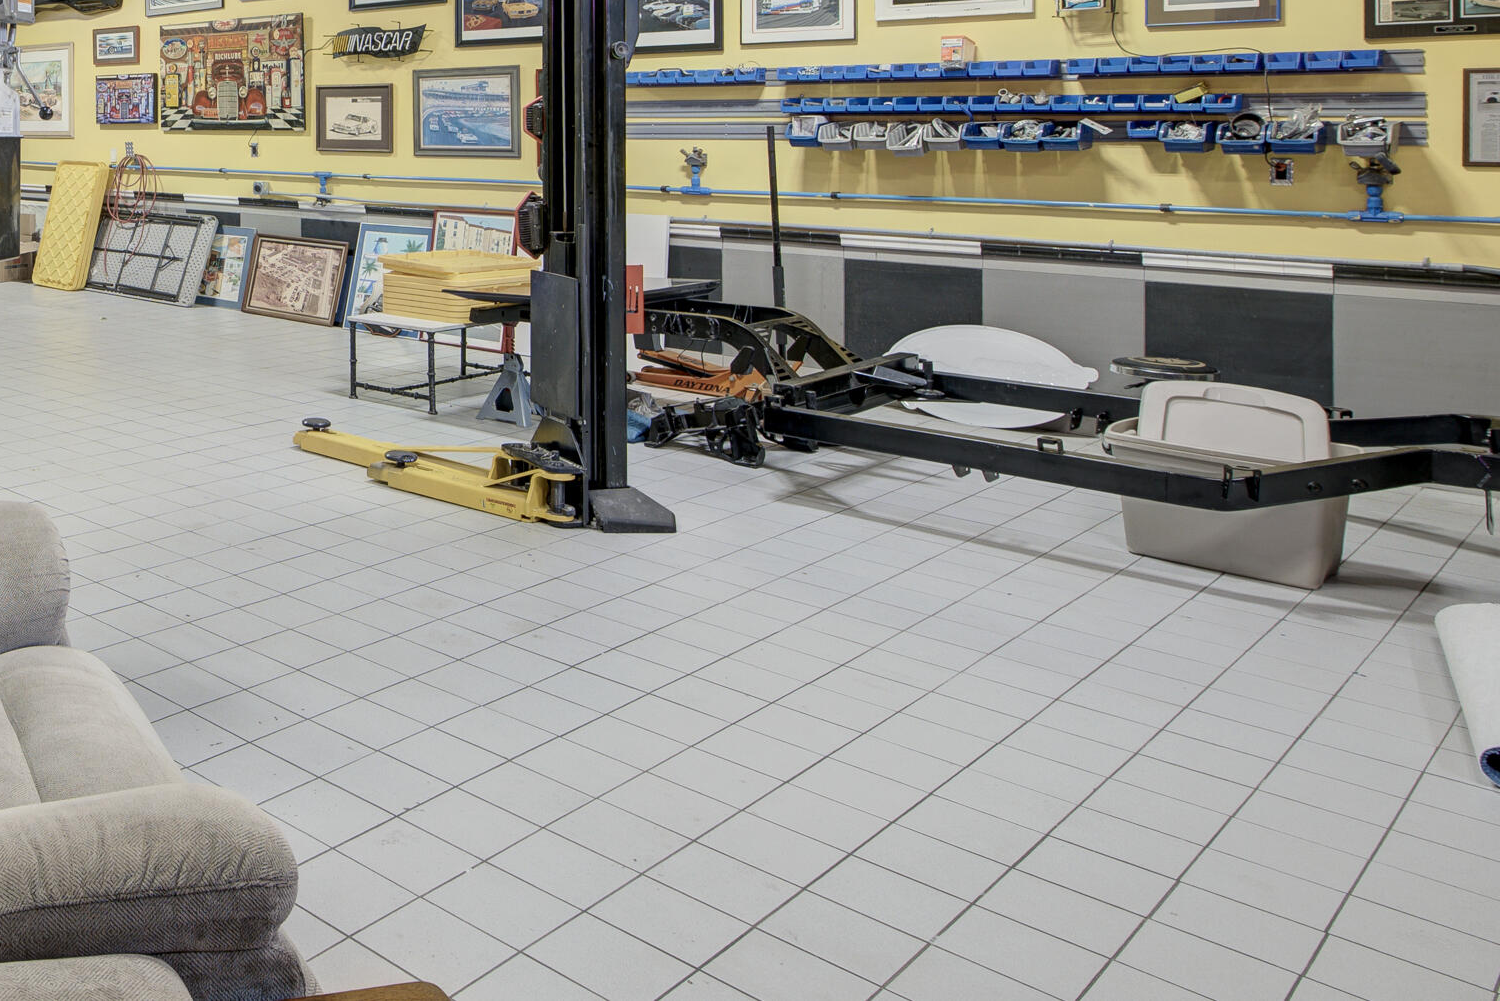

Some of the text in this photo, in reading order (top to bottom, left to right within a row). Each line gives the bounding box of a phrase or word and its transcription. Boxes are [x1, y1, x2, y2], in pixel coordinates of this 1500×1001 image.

[351, 30, 413, 52] NASCAR
[261, 62, 285, 72] Mobil
[673, 379, 730, 394] DAYTONA
